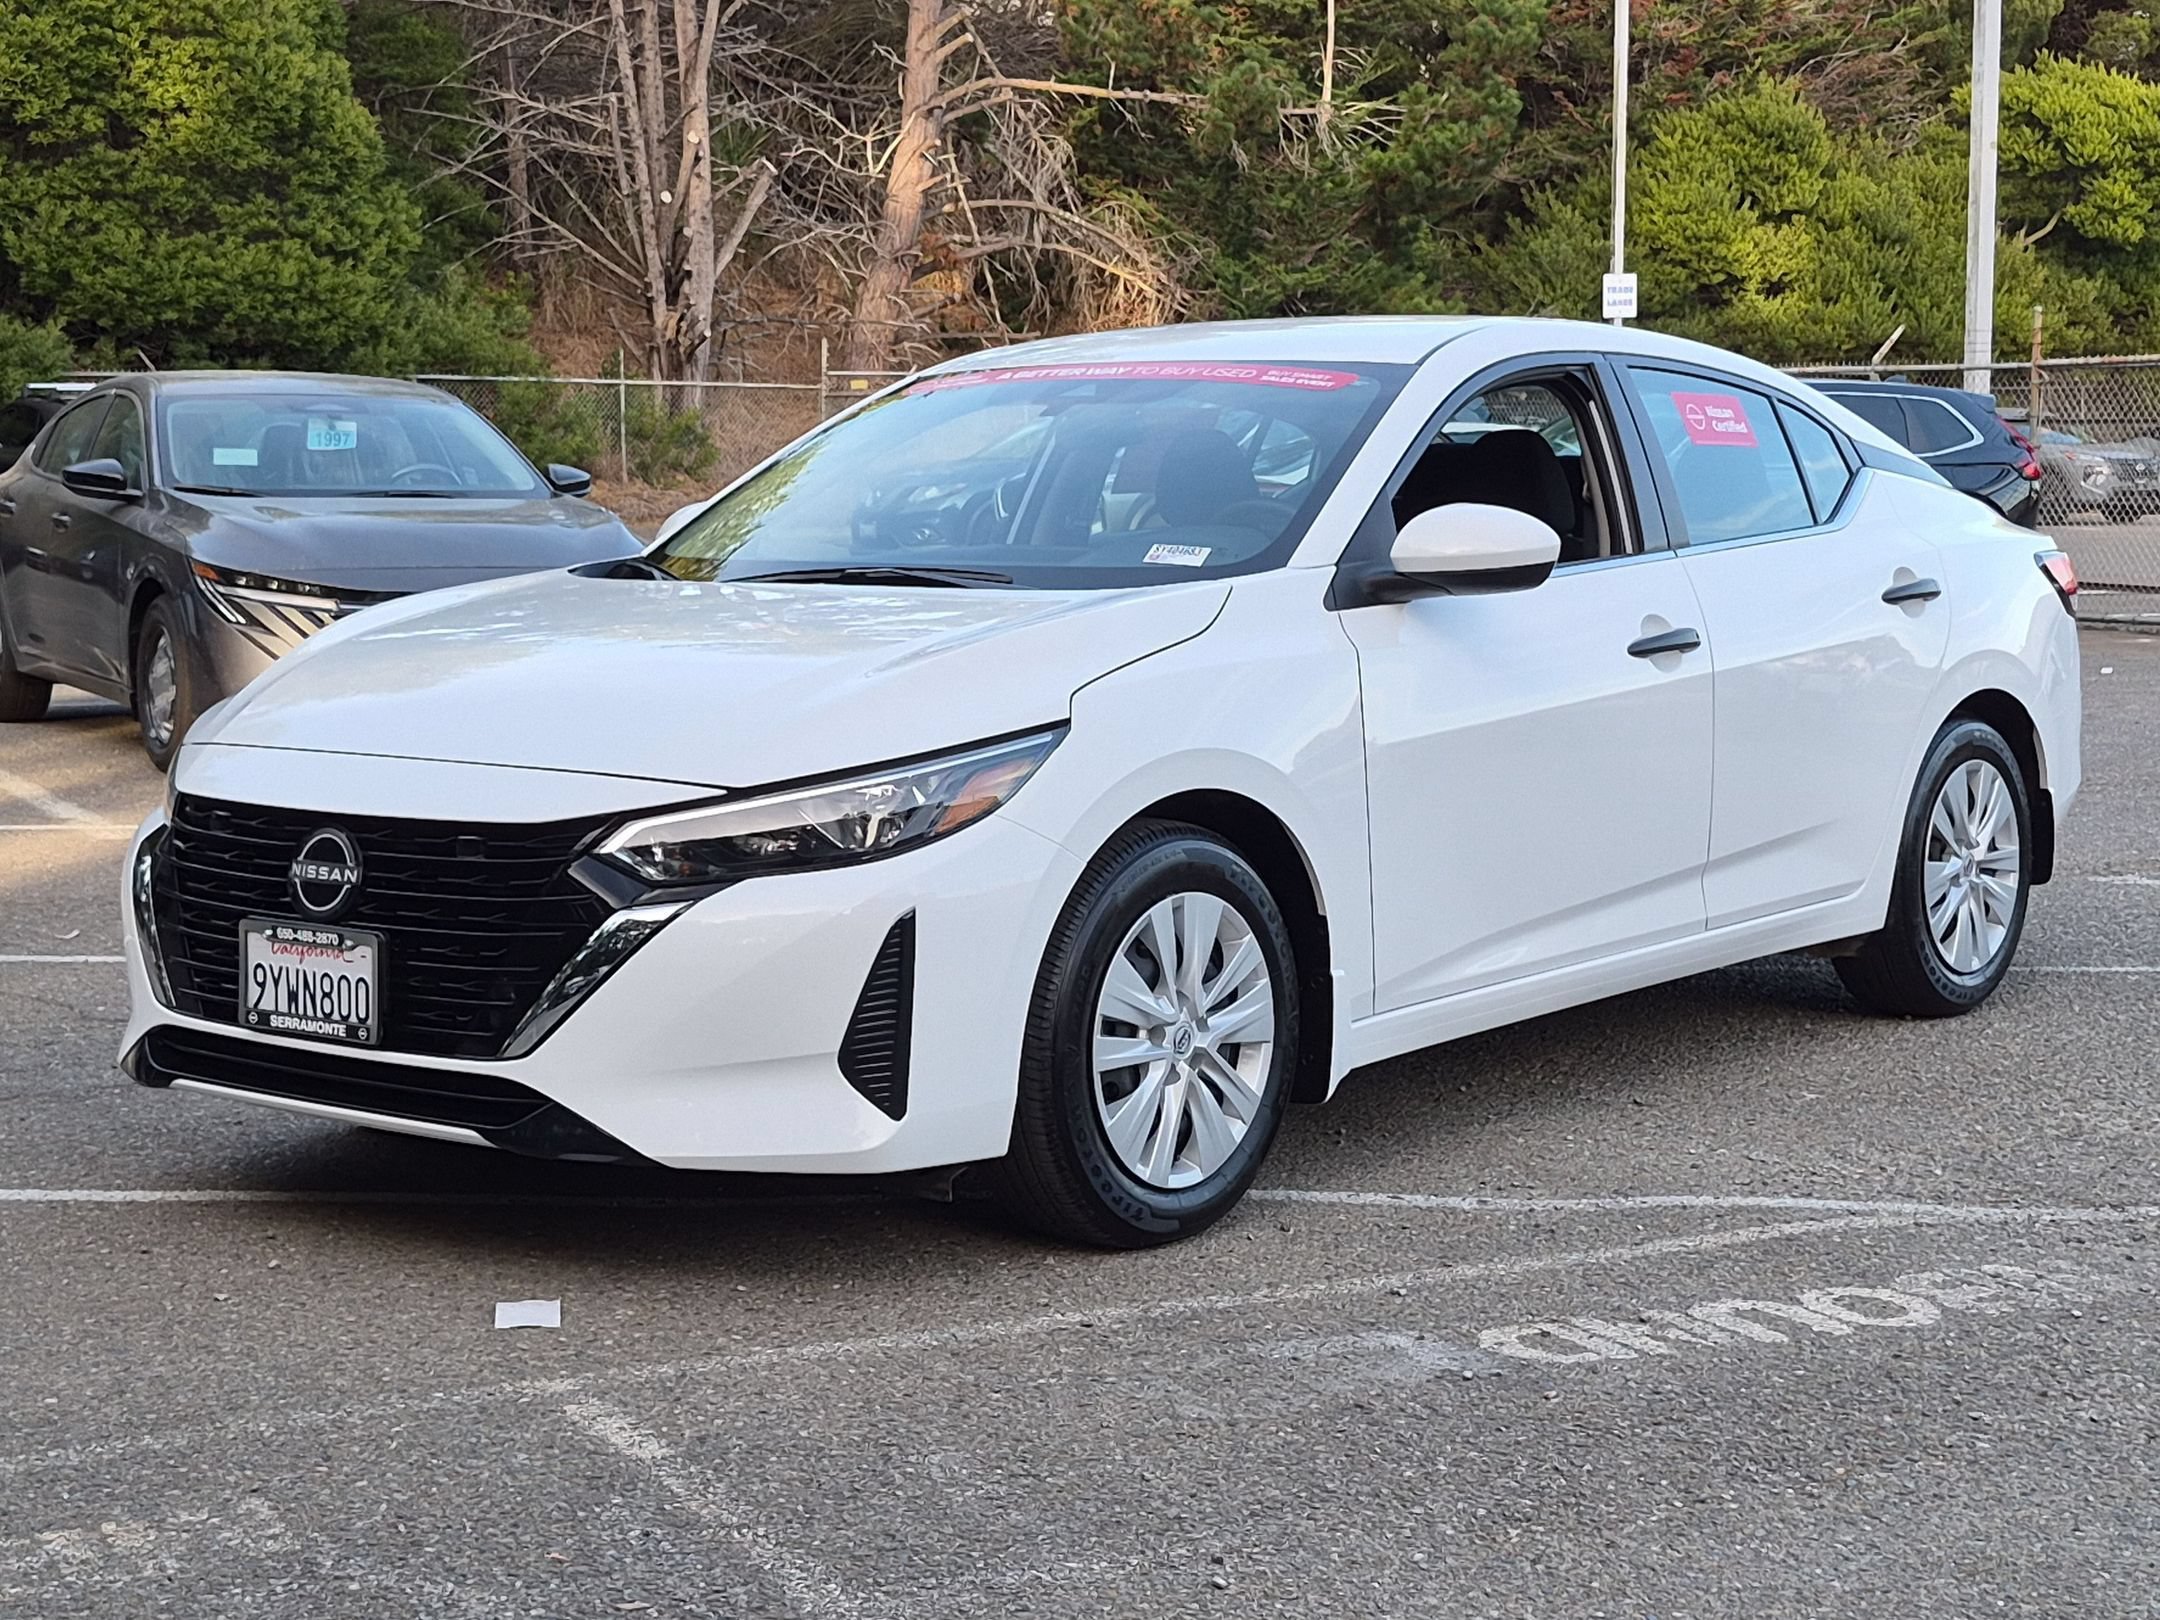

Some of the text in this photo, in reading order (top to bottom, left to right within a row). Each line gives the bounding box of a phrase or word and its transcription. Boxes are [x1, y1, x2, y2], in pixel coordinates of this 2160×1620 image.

[996, 366, 1256, 381] A BETTER WAY TO BUY USED
[1266, 369, 1293, 378] BUY
[316, 431, 350, 448] 1997
[292, 862, 358, 883] NISSAN
[252, 961, 371, 1025] 9YWN800
[269, 1014, 347, 1038] SERRAMONTE
